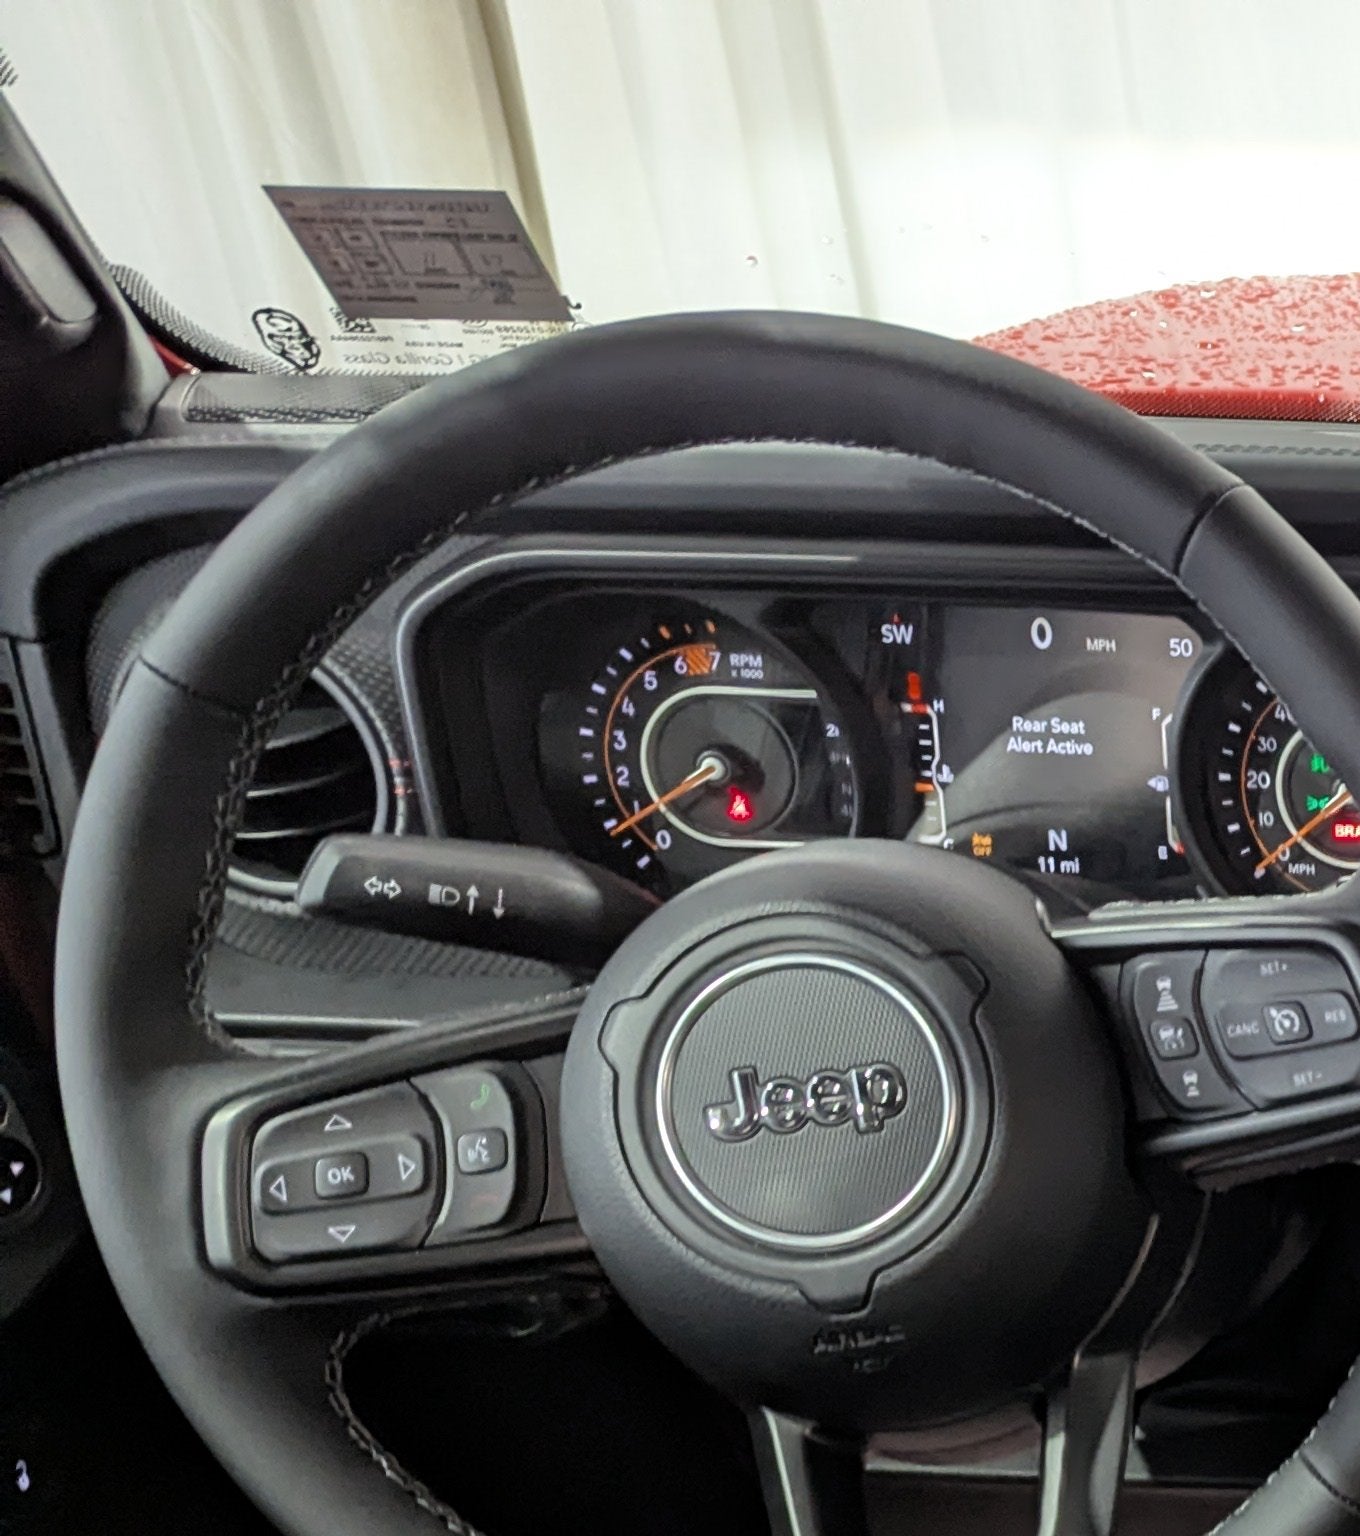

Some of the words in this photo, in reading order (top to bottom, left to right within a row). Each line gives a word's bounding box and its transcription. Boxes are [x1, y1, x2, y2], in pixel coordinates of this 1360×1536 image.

[880, 624, 914, 646] SW
[1030, 616, 1053, 650] 0
[1085, 637, 1117, 653] MPH
[1169, 637, 1194, 657] 50
[673, 656, 688, 675] 6
[708, 650, 721, 671] 7
[728, 652, 764, 669] RPM
[643, 670, 659, 691] 5
[741, 667, 764, 680] 1000
[621, 697, 636, 717] 4
[933, 699, 945, 714] H
[1012, 715, 1047, 734] Rear
[1049, 716, 1086, 735] Seat
[612, 730, 628, 751] 3
[1006, 736, 1044, 754] Alert
[1045, 737, 1094, 756] Active
[1257, 735, 1278, 752] 30
[616, 768, 630, 788] 2
[1246, 770, 1271, 790] 20
[1258, 811, 1275, 828] 10
[655, 829, 672, 850] 0
[1048, 828, 1068, 851] N
[1037, 856, 1056, 873] 11
[1059, 857, 1081, 874] mi
[1287, 856, 1316, 876] MPH
[703, 1060, 907, 1142] Jeep
[327, 1166, 356, 1185] OK
